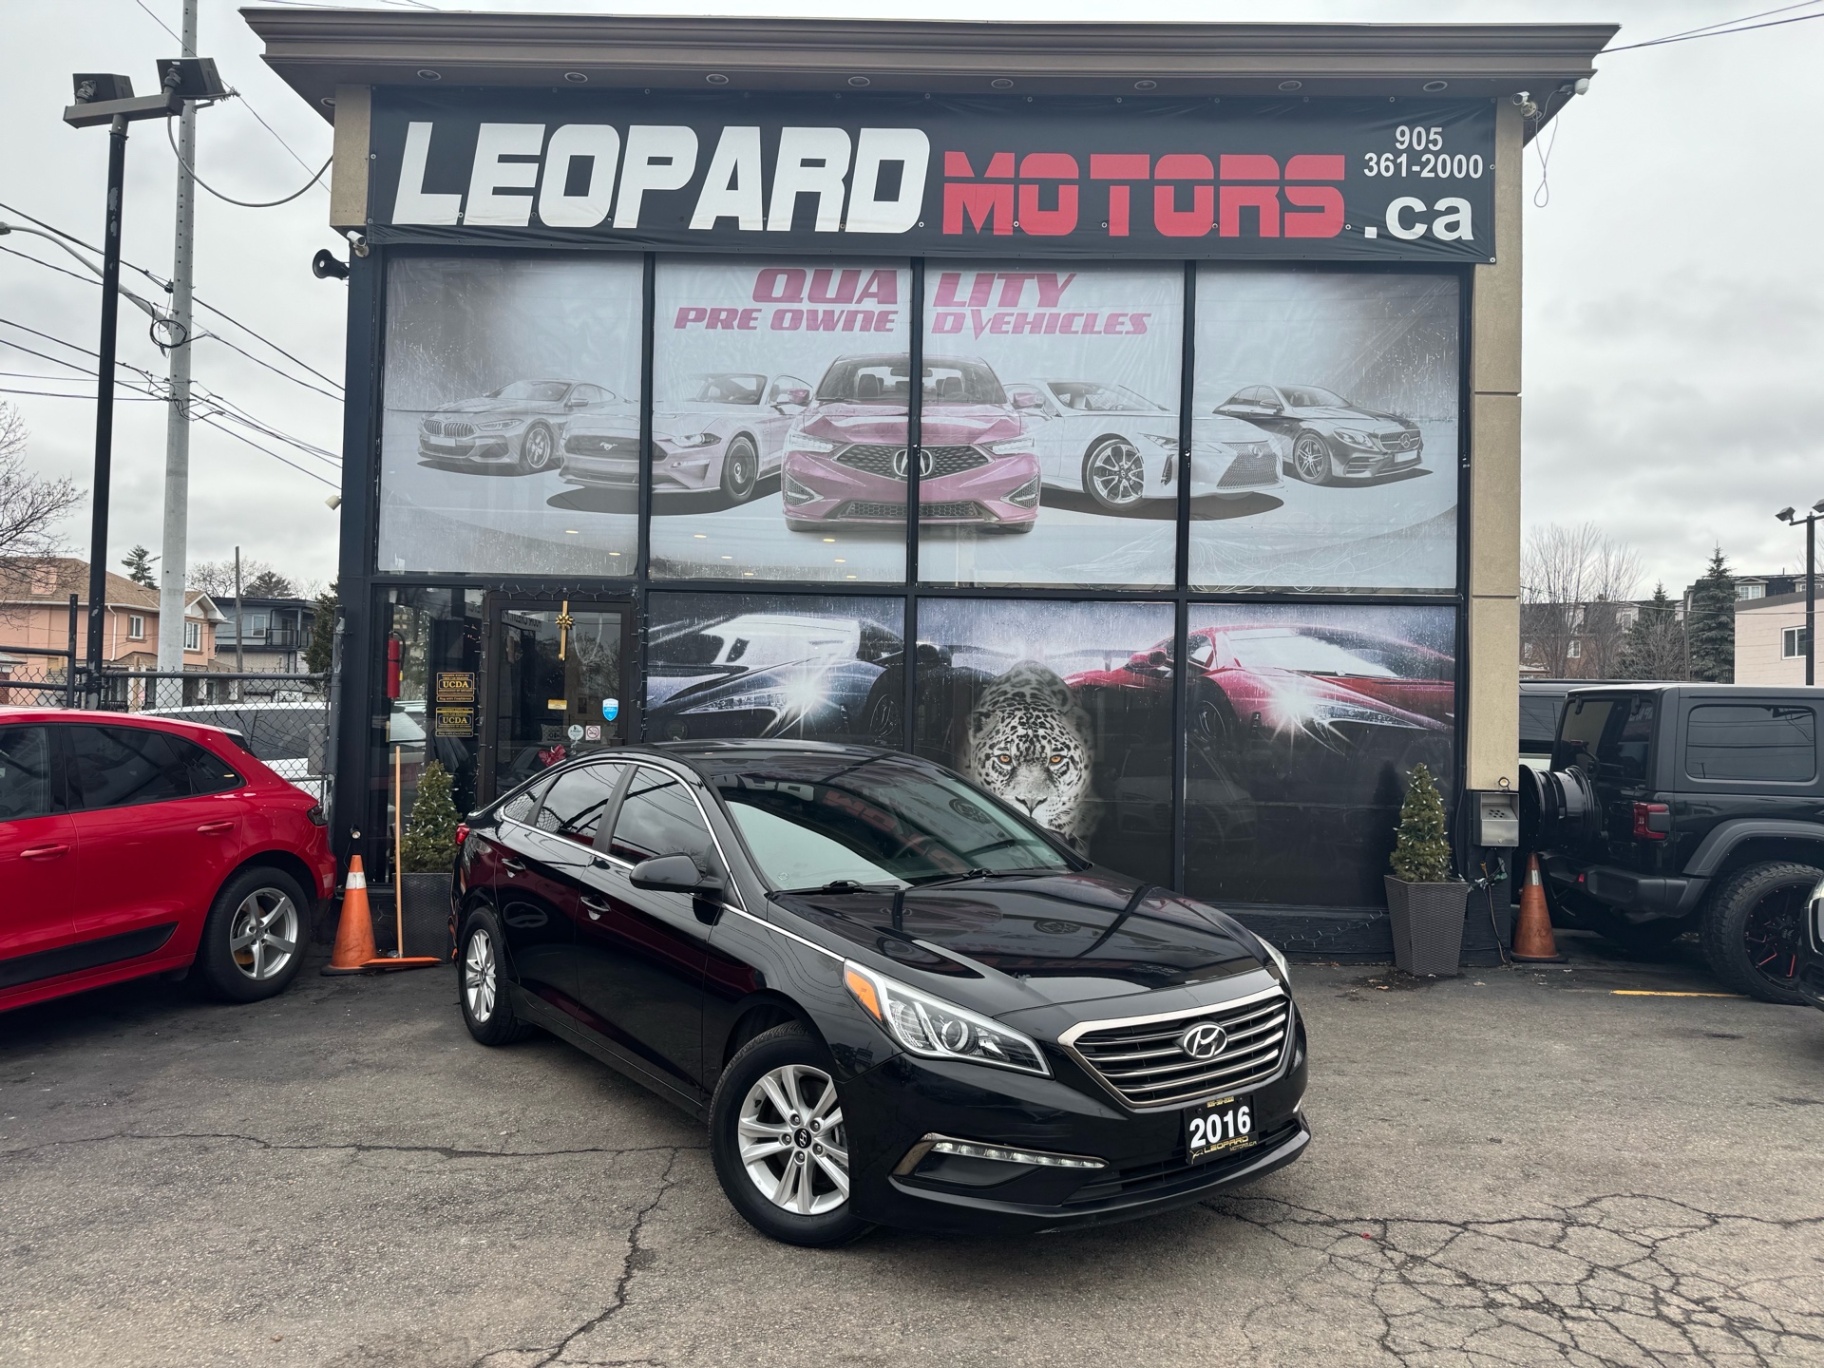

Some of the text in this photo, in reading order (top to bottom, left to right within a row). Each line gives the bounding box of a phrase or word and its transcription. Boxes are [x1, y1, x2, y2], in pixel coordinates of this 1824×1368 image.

[1395, 125, 1443, 151] 905
[1363, 152, 1484, 179] 361-2000
[391, 121, 1345, 238] LEOPARD MOTORS
[1364, 196, 1475, 241] .ca
[752, 268, 1076, 307] QUA LITY
[674, 307, 762, 330] PRE
[770, 309, 898, 332] OWNE
[443, 680, 469, 688] UCDA
[442, 716, 468, 724] UCDA
[1189, 1105, 1251, 1149] 2016
[1204, 1135, 1249, 1153] LEOPARD
